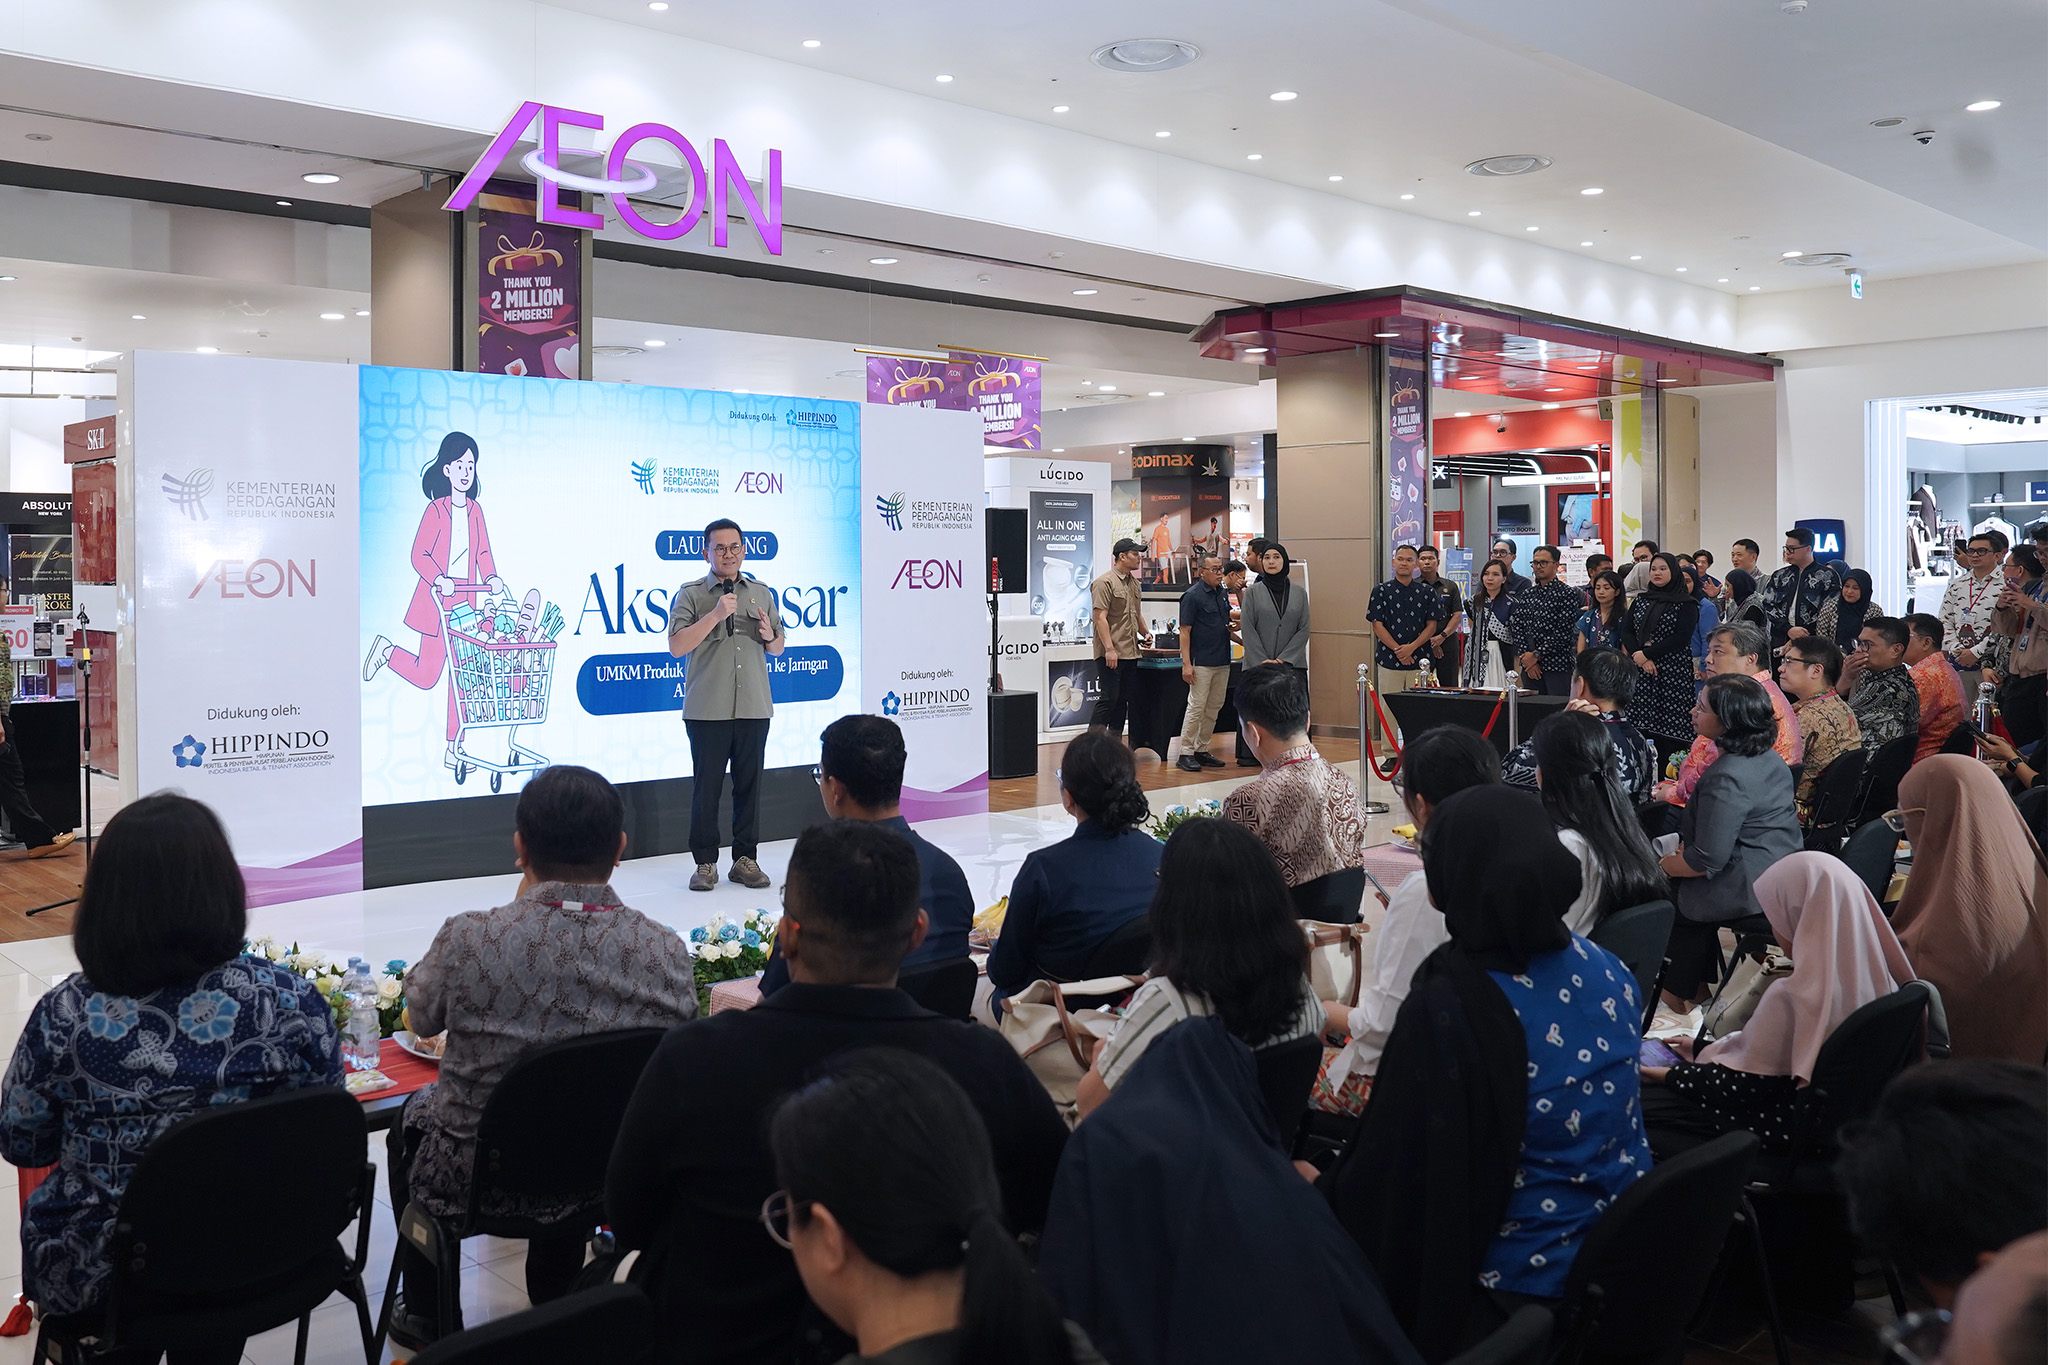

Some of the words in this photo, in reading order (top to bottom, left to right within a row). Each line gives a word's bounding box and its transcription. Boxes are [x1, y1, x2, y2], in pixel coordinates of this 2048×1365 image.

[503, 277, 532, 288] THANK
[534, 276, 552, 286] YOU
[491, 291, 502, 309] 2
[506, 288, 564, 308] MILLION
[503, 308, 554, 322] MEMBERS!!
[923, 399, 936, 408] YOU
[978, 395, 1000, 404] THANK
[1000, 393, 1014, 402] YOU
[730, 411, 760, 422] Didukung
[798, 412, 836, 423] HIPPINDO
[983, 403, 1022, 421] MILLION
[984, 420, 1014, 433] EMBERS!!
[1392, 416, 1397, 428] 2
[1398, 412, 1420, 426] MILLION
[663, 467, 719, 478] KEMENTERIAN
[663, 476, 719, 487] PERDAGANGAN
[226, 482, 335, 495] KEMENTERIAN
[226, 495, 335, 508] PERDAGANGAN
[912, 502, 972, 512] KEMENTERIAN
[228, 510, 277, 518] REPUBLIK
[281, 510, 335, 518] INDONESIA
[912, 511, 972, 522] PERDAGANGAN
[1036, 520, 1054, 530] ALL
[1056, 520, 1064, 530] IN
[1066, 520, 1086, 530] ONE
[668, 535, 767, 554] LAUNG
[1813, 533, 1839, 552] LA
[574, 564, 677, 636] Aks
[462, 623, 476, 632] MILK
[596, 664, 641, 682] UMKM
[644, 662, 684, 678] Produk
[774, 658, 786, 672] ke
[788, 657, 828, 674] Jaringan
[901, 671, 936, 680] Didukung
[937, 669, 954, 678] oleh:
[904, 688, 970, 706] HIPPINDO
[208, 707, 268, 720] Didukung
[272, 704, 300, 716] oleh:
[212, 730, 328, 754] HIPPINDO
